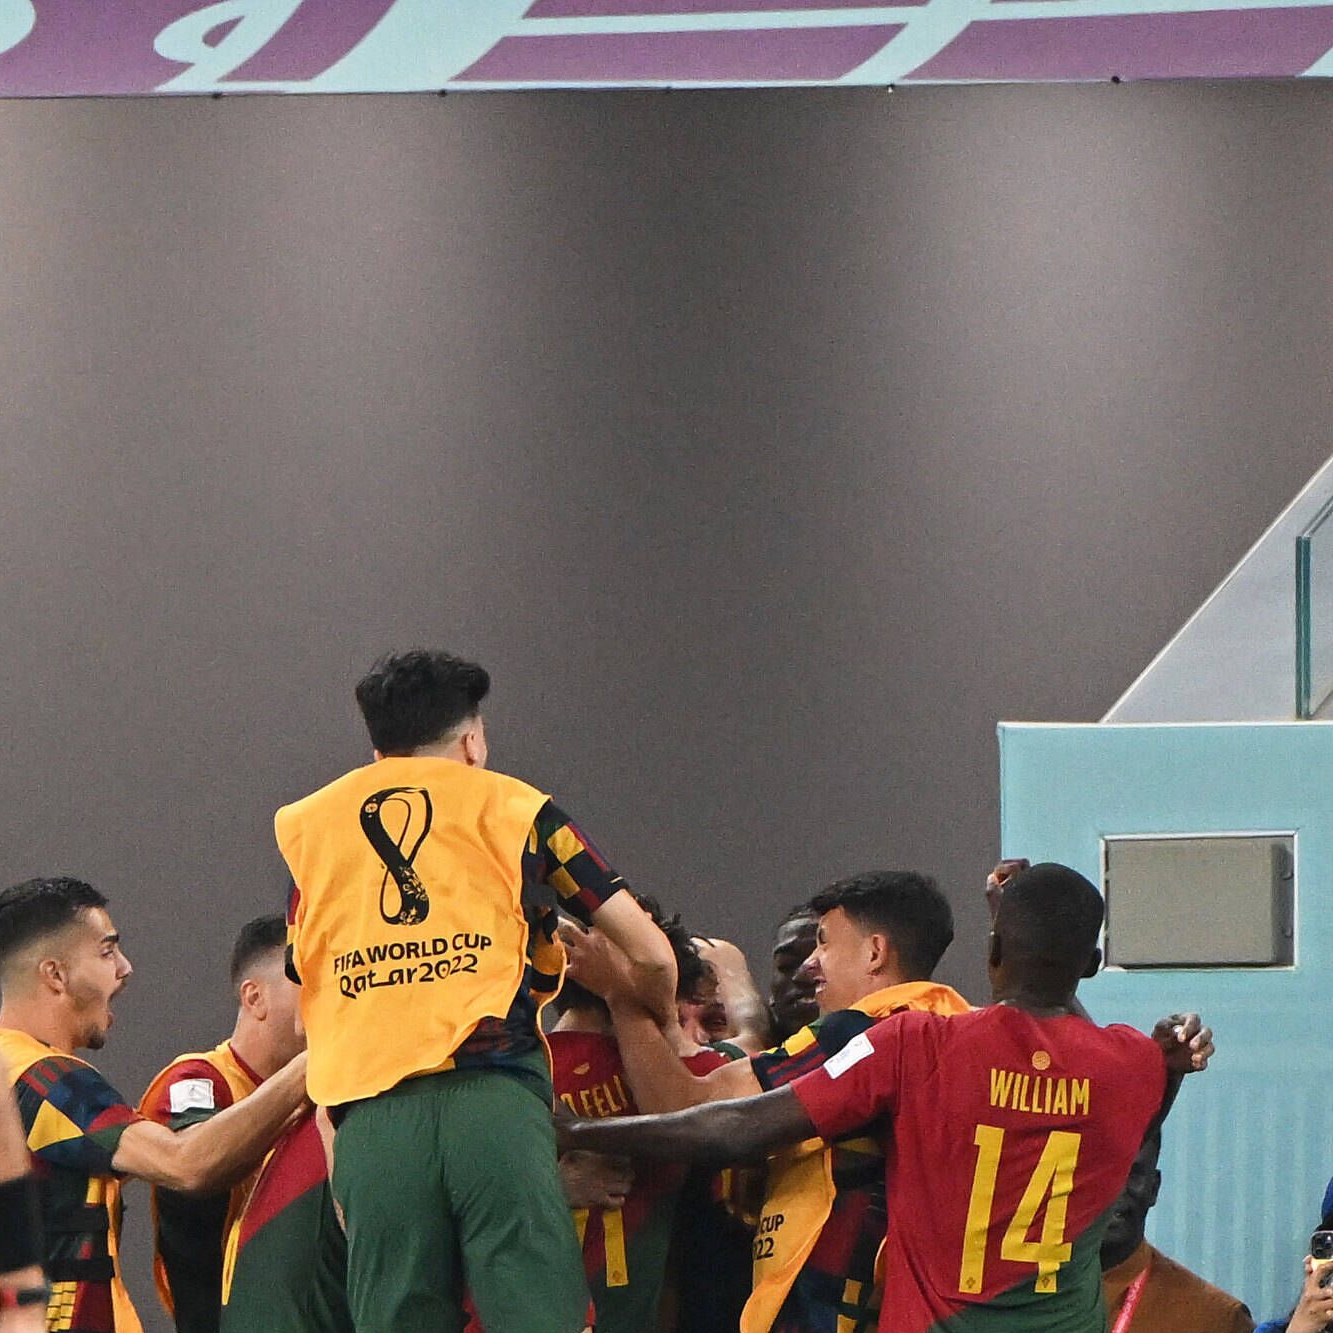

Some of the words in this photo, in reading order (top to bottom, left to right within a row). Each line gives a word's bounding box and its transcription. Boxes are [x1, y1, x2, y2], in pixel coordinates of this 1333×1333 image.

[333, 949, 366, 975] FIFA
[365, 937, 449, 964] WORLD
[451, 932, 493, 952] CUP
[989, 1067, 1091, 1116] WILLIAM
[958, 1123, 1082, 1294] 14
